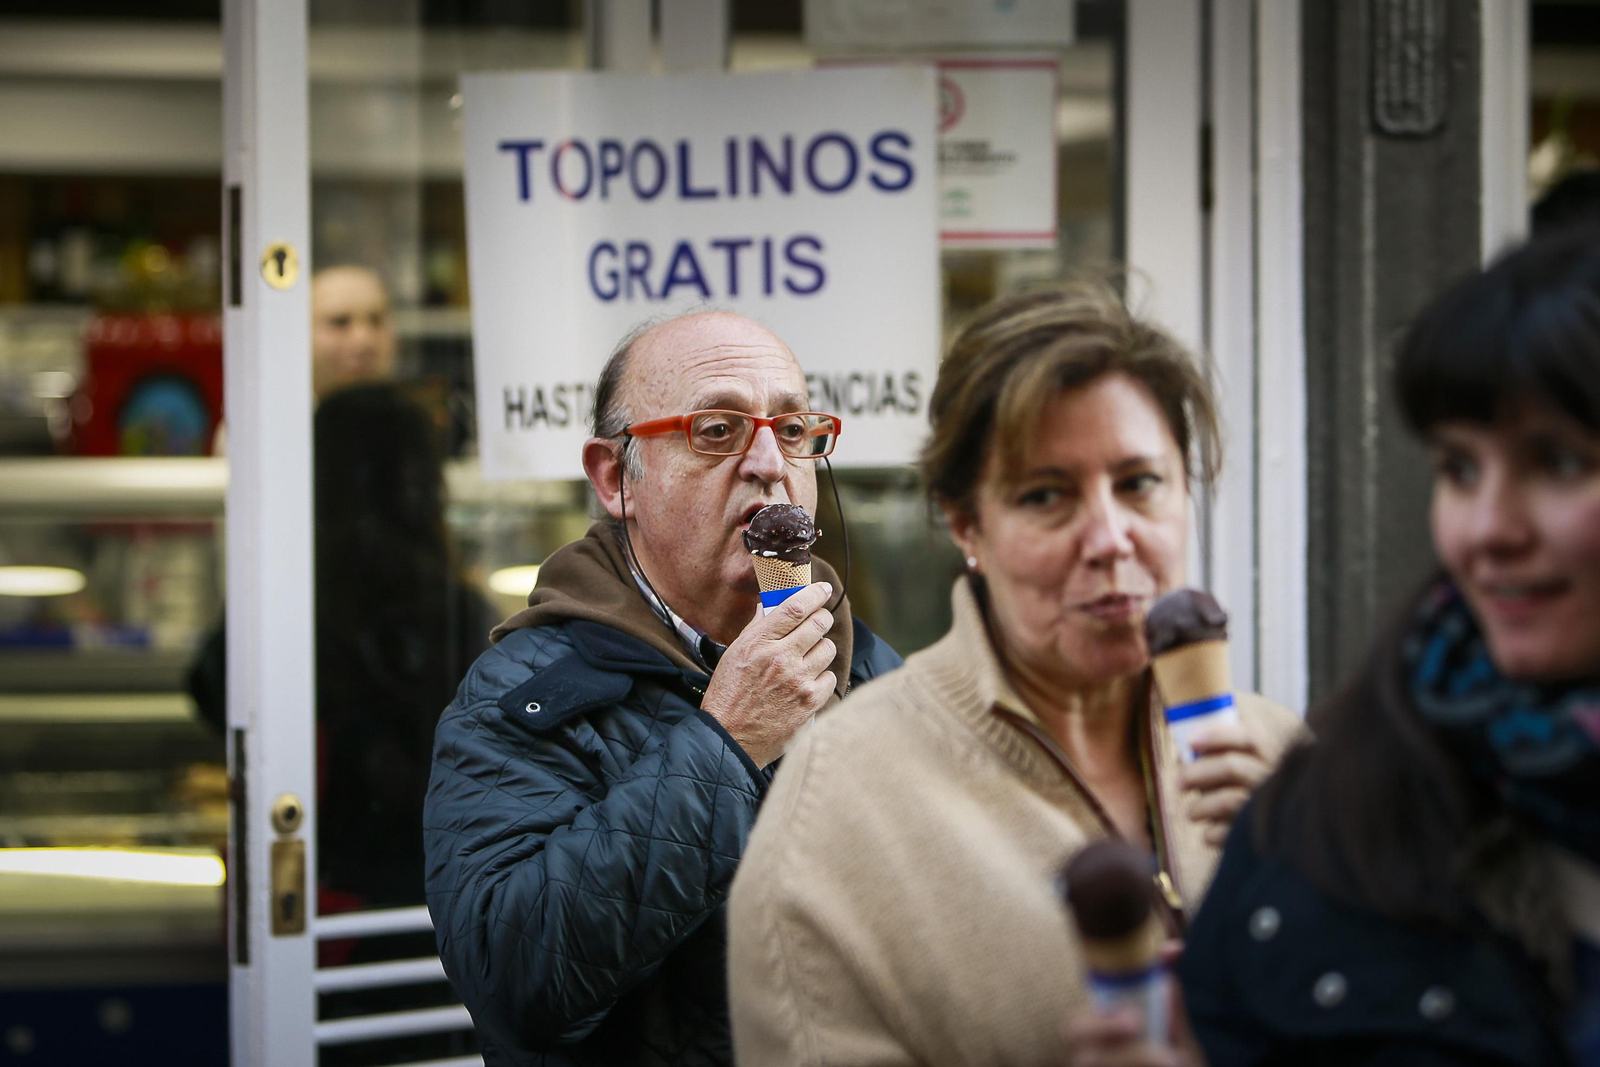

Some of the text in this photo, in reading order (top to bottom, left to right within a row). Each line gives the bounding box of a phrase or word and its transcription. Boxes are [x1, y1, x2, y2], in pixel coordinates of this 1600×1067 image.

[498, 130, 916, 203] TOPOLINOS
[588, 234, 828, 302] GRATIS
[502, 370, 921, 430] HAST ENCIAS
